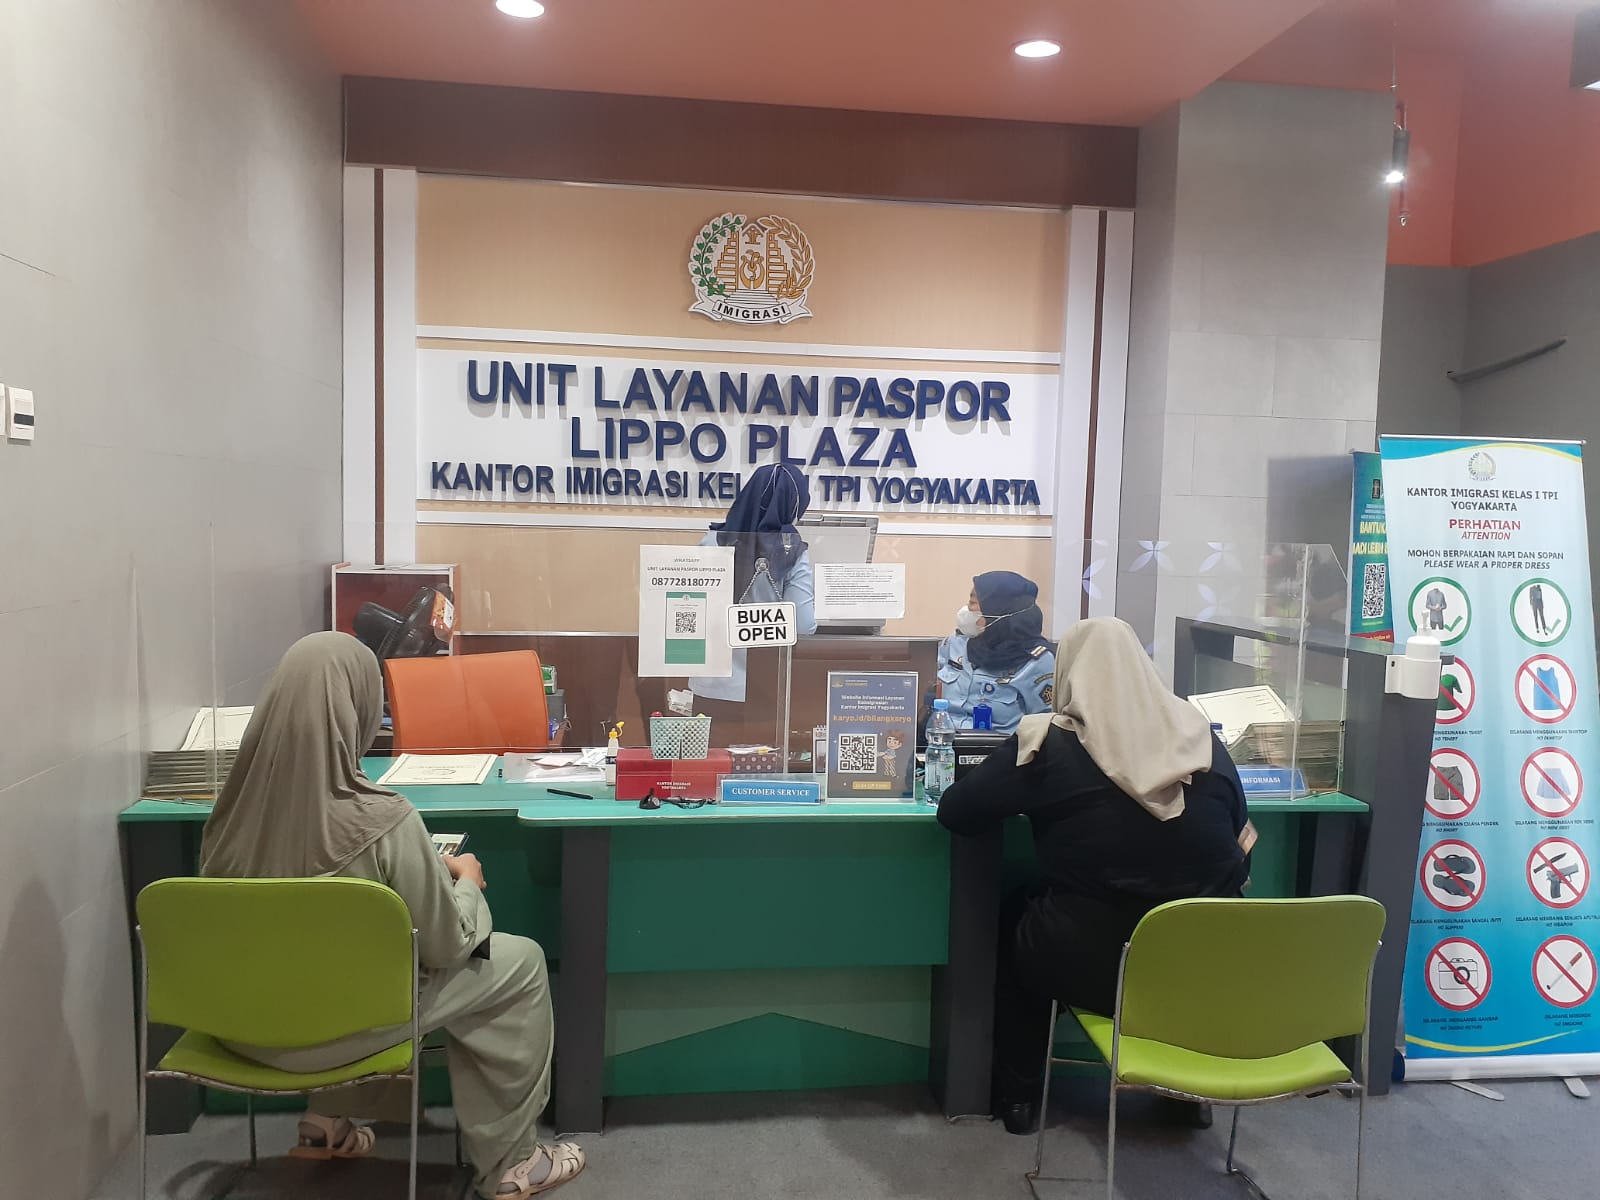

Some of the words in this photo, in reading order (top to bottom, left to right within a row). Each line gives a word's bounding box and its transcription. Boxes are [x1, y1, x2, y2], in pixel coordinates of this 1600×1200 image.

[717, 302, 786, 319] IMIGRASI
[468, 359, 577, 406] UNIT
[594, 366, 819, 416] LAYANAN
[833, 376, 1012, 421] PASPOR
[571, 416, 727, 463] LIPPO
[748, 424, 917, 467] PLAZA
[432, 461, 555, 493] KANTOR
[566, 466, 688, 498] IMIGRASI
[819, 475, 861, 502] TPI
[871, 477, 1041, 506] YOGYAKARTA
[1407, 488, 1448, 498] KANTOR
[1451, 488, 1500, 499] IMIGRASI
[1502, 489, 1533, 500] KELAS
[1535, 490, 1540, 500] I
[1542, 490, 1558, 500] TPI
[1450, 501, 1518, 512] YOGYAKARTA
[1449, 519, 1521, 530] PERHATIAN
[1461, 531, 1511, 541] ATTENTION
[1407, 549, 1441, 558] MOHON
[1443, 549, 1495, 559] BERPAKAIAN
[1497, 550, 1515, 559] RAPI
[1517, 550, 1536, 560] DAN
[1537, 551, 1564, 560] SOPAN
[1423, 560, 1454, 569] PLEASE
[1456, 560, 1480, 569] WEAR
[1482, 560, 1489, 569] A
[1491, 561, 1523, 570] PROPER
[1525, 561, 1550, 570] DRESS
[652, 577, 721, 587] 087728180777
[737, 608, 786, 624] BUKA
[738, 626, 787, 642] OPEN
[732, 787, 775, 796] CUSTOMER
[777, 788, 811, 797] SERVICE
